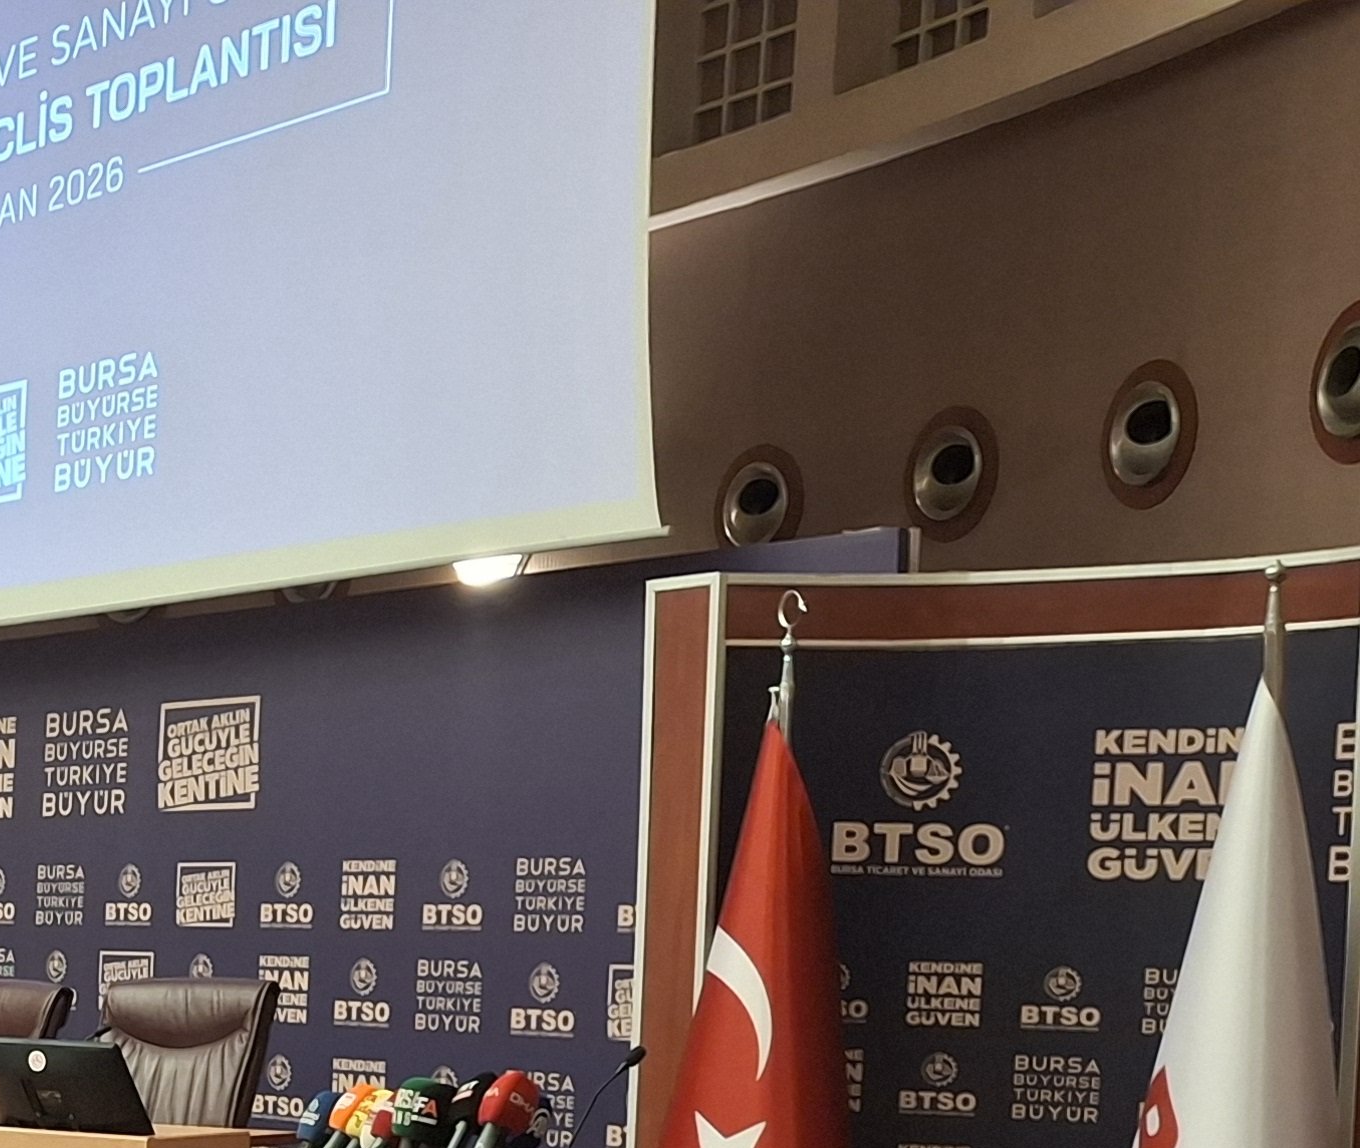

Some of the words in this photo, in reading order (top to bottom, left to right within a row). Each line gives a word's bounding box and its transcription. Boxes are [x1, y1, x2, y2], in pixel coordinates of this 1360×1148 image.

[85, 0, 336, 129] TOPLANTISI
[48, 157, 125, 212] 2026
[58, 351, 158, 400] BURSA
[54, 446, 156, 493] BÜYÜR
[45, 707, 129, 738] BURSA
[167, 716, 209, 738] ORTAK
[211, 707, 250, 730] AKLIN
[1094, 726, 1246, 755] KENDİN
[42, 788, 126, 817] BÜYÜR
[1089, 812, 1222, 841] ÜLKE
[831, 821, 1005, 866] BTSO
[37, 864, 85, 879] BURSA
[515, 857, 586, 876] BURSA
[105, 902, 152, 921] BTSO
[260, 903, 313, 923] BTSO
[422, 904, 483, 925] BTSO
[513, 914, 584, 932] BÜYÜR
[417, 959, 482, 978] BURSA
[333, 1000, 390, 1023] BTSO
[510, 1008, 575, 1032] BTSO
[1020, 1005, 1101, 1026] BTSO
[414, 1014, 480, 1034] BÜYÜR
[1014, 1054, 1101, 1075] BURSA
[251, 1093, 304, 1117] BTSO
[898, 1090, 977, 1112] BTSO
[1011, 1103, 1099, 1123] BÜYÜR
